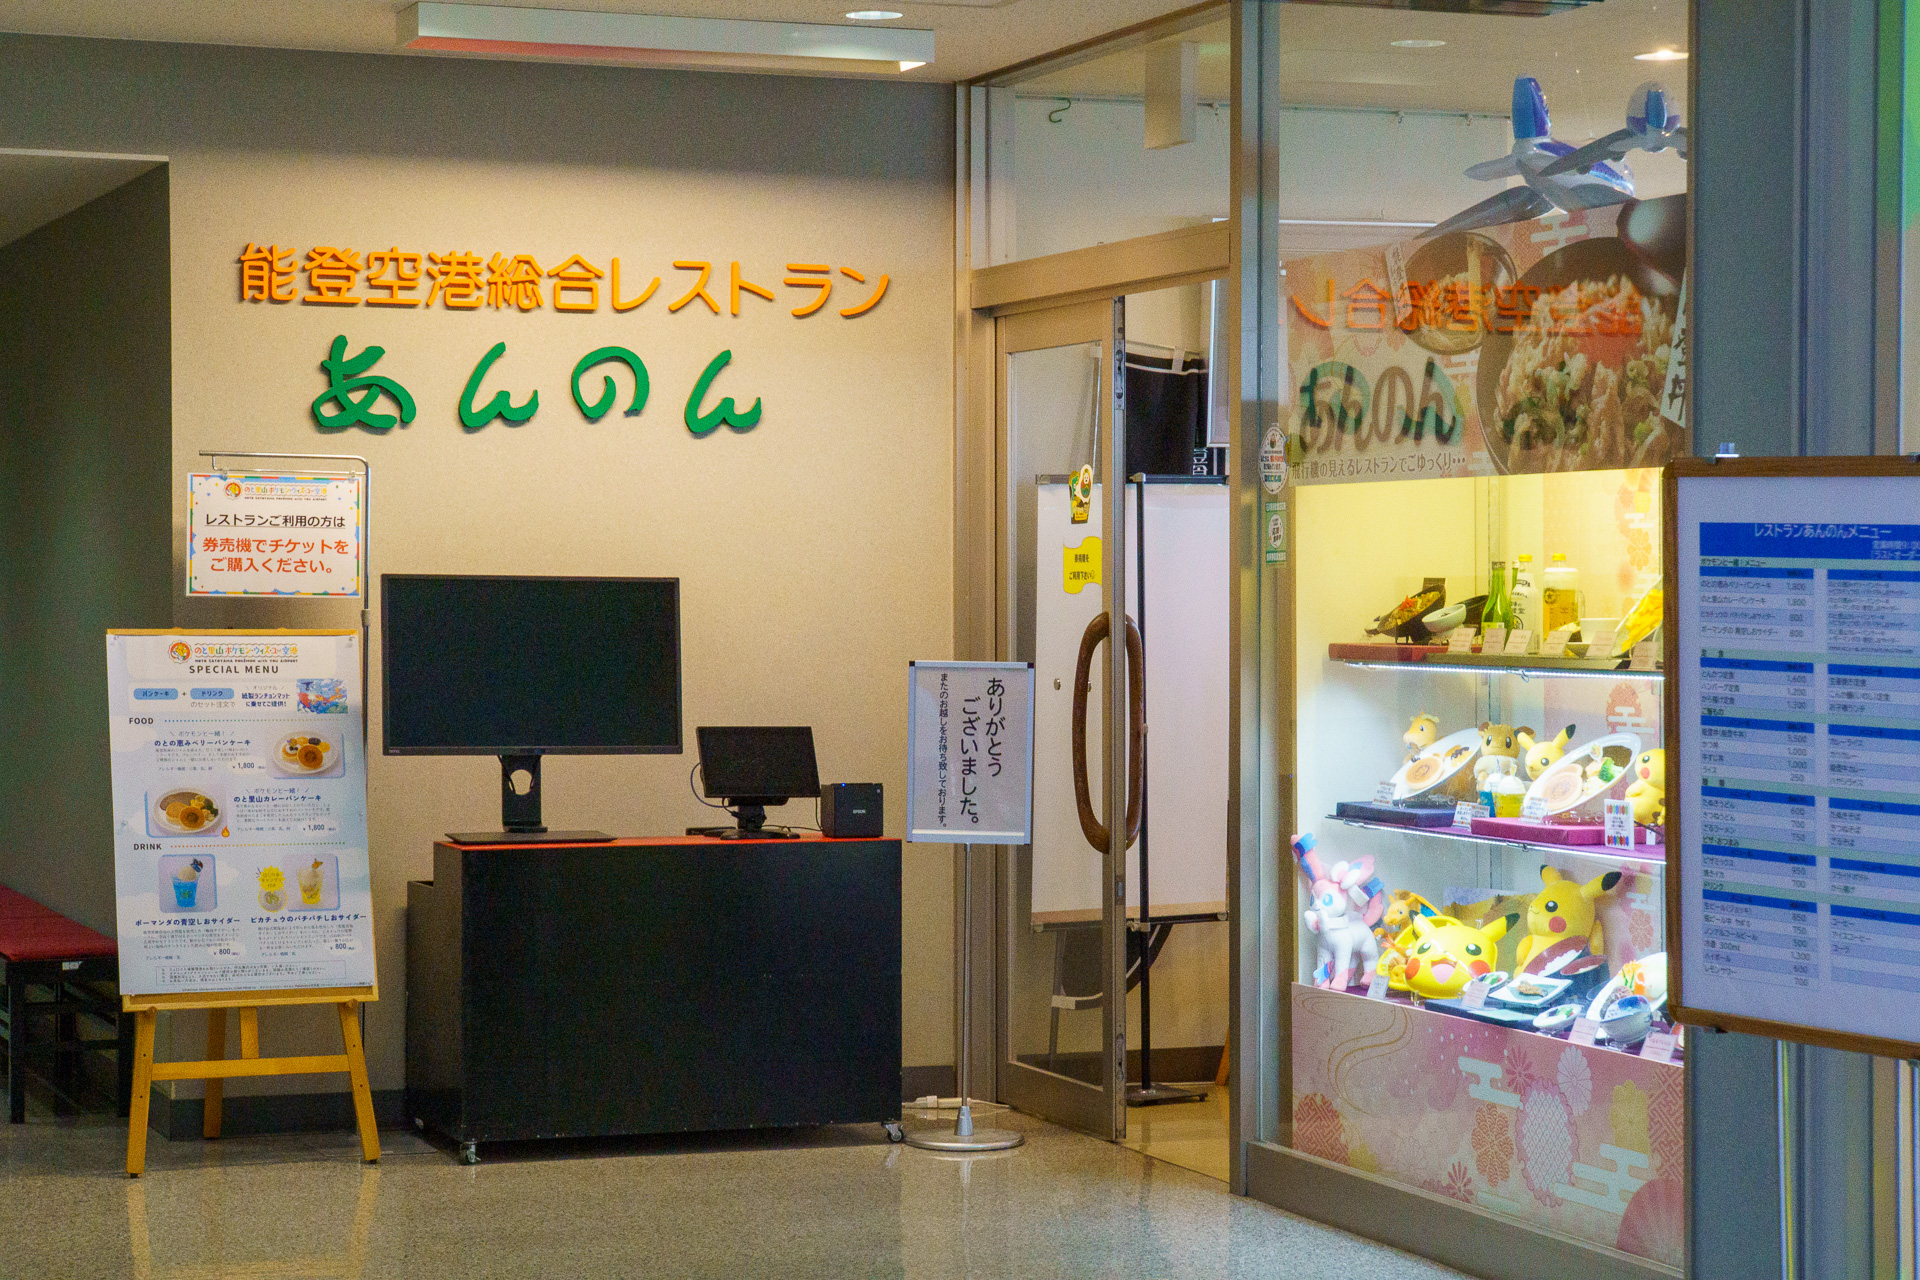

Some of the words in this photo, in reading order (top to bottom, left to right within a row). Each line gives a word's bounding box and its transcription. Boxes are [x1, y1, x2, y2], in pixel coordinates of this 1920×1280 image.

[240, 242, 890, 318] 能登空港総合レストラン
[311, 335, 762, 437] あんのん
[205, 513, 346, 527] レストランご利用の方は
[1754, 524, 1892, 539] レストランあんのんメニュー
[202, 536, 349, 555] 券売機でチケットを
[210, 556, 332, 574] ご購入ください。
[189, 665, 240, 674] SPECIAL
[245, 665, 279, 674] MENU
[128, 717, 154, 725] FOOD
[985, 677, 1006, 778] ありがとう
[937, 673, 950, 828] またのお越しをお待ち致しております。
[960, 696, 982, 824] ございました。
[307, 824, 325, 832] 1,800
